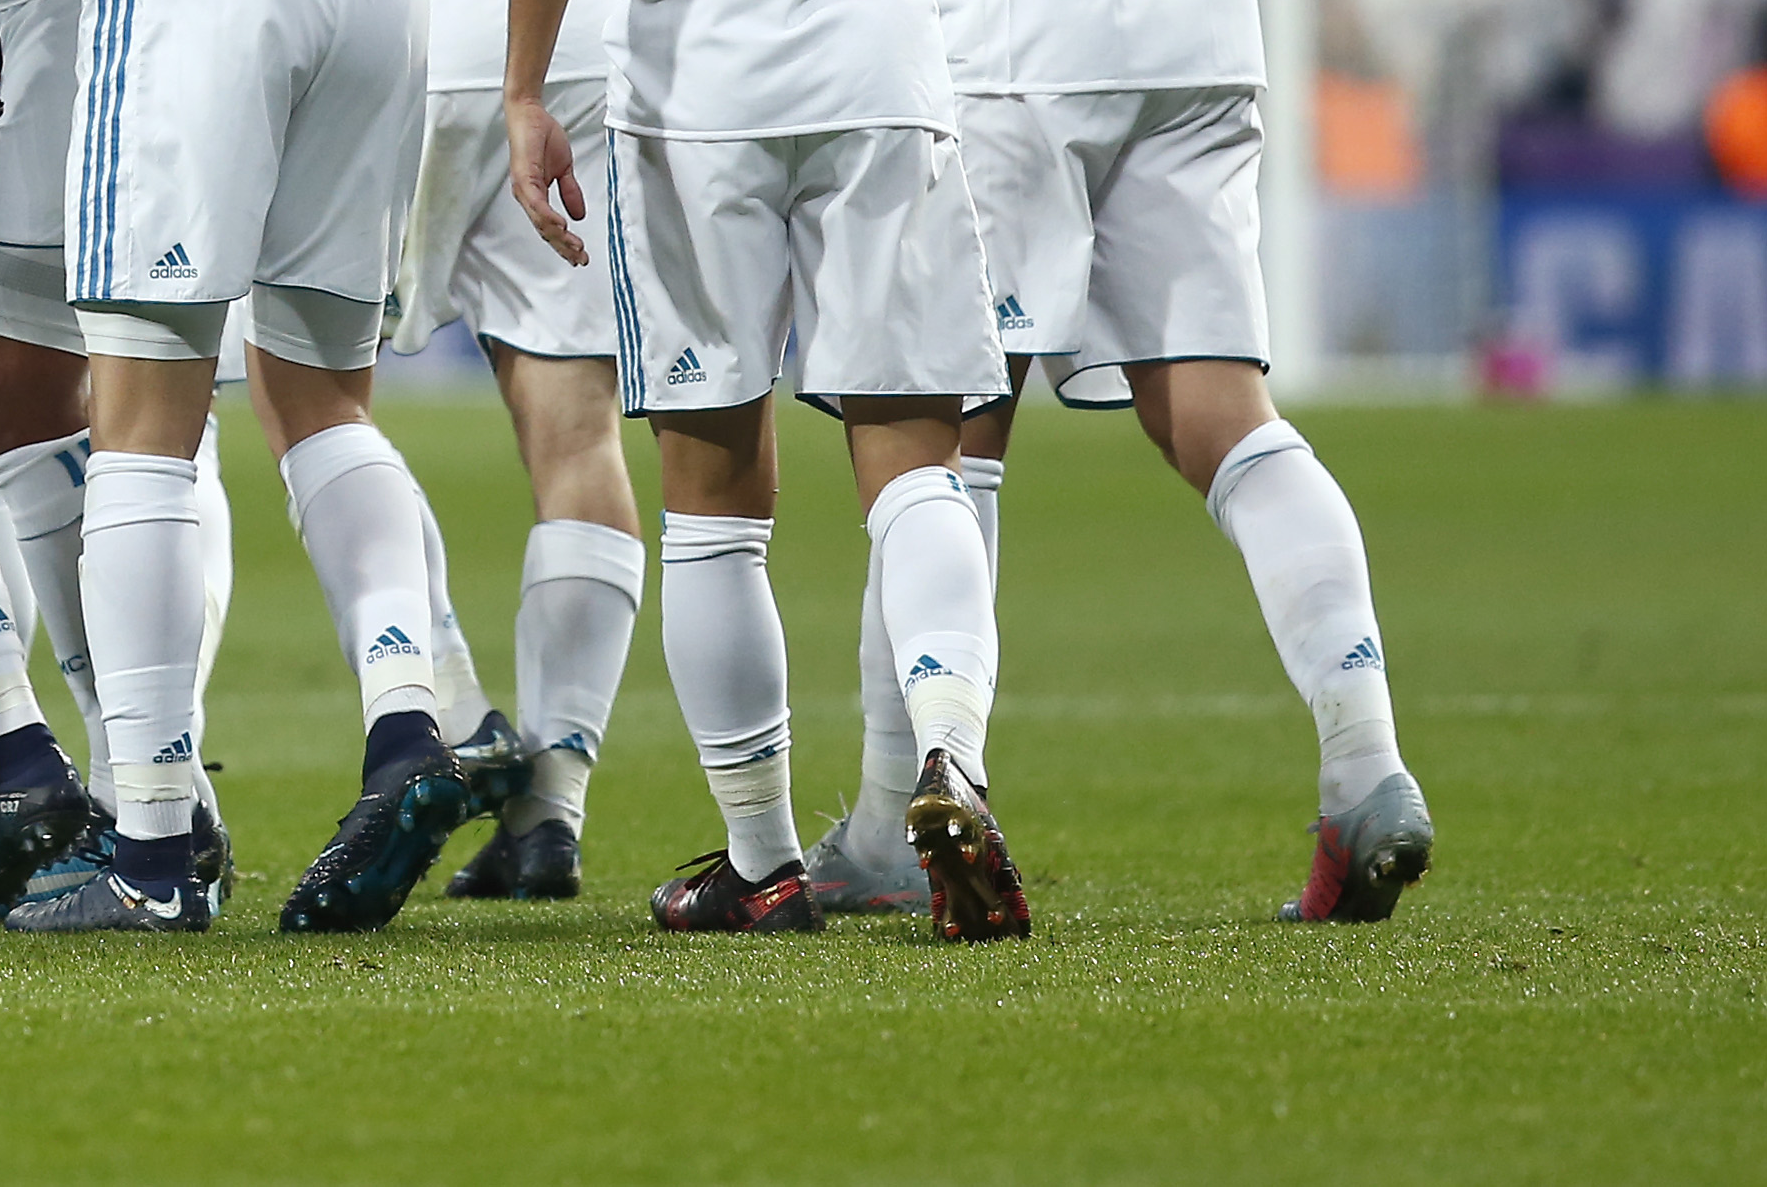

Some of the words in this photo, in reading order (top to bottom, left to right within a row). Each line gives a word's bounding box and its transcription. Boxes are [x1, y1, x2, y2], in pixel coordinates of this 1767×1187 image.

[149, 265, 199, 279] adidas
[667, 370, 707, 385] adidas
[366, 644, 421, 665] adidas
[0, 800, 21, 813] CR7
